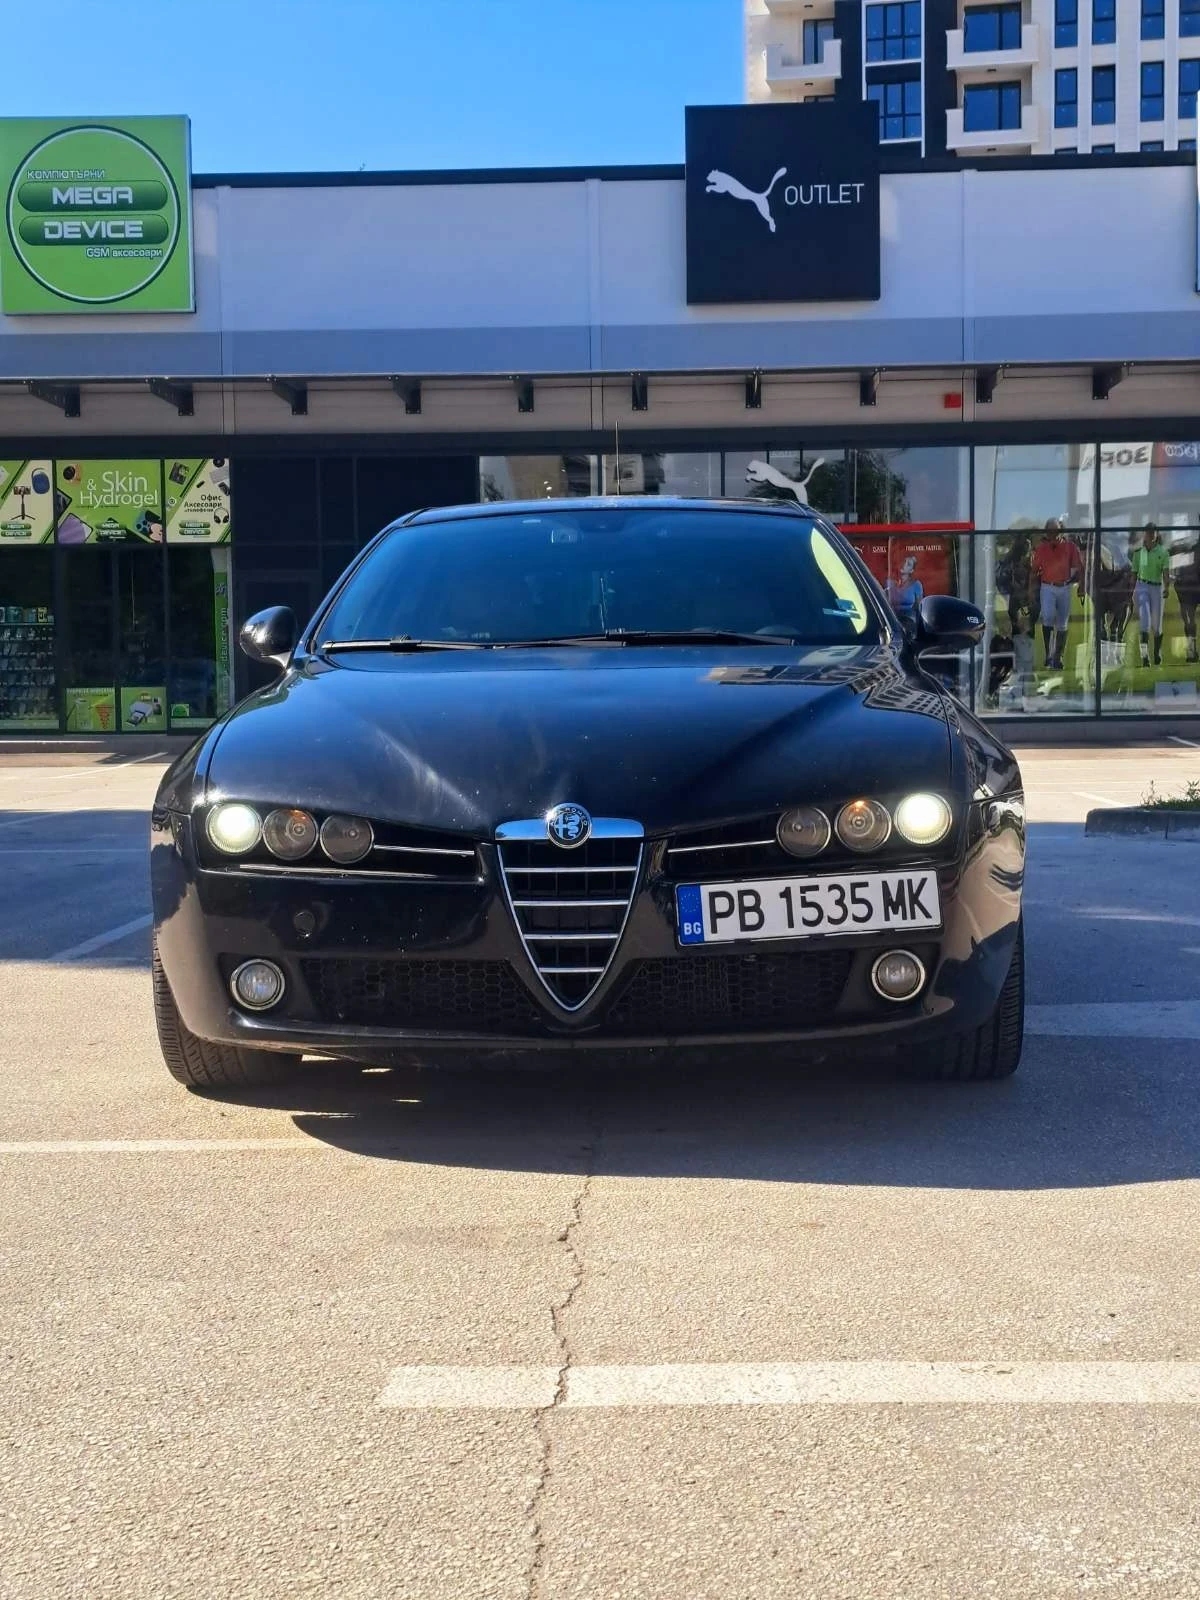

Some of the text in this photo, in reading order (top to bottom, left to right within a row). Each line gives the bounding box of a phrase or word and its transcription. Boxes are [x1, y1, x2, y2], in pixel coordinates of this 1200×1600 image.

[27, 169, 105, 180] КОМПЮТЪРНИ
[52, 187, 133, 205] MEGA
[785, 183, 865, 206] OUTLET
[43, 220, 144, 239] DEVICE
[86, 247, 163, 259] GSM аксесоари
[87, 470, 148, 492] & Skin
[80, 489, 158, 509] Hydrogel
[200, 493, 223, 502] Офис
[708, 877, 932, 934] PB 1535 MK
[684, 922, 701, 935] BG
